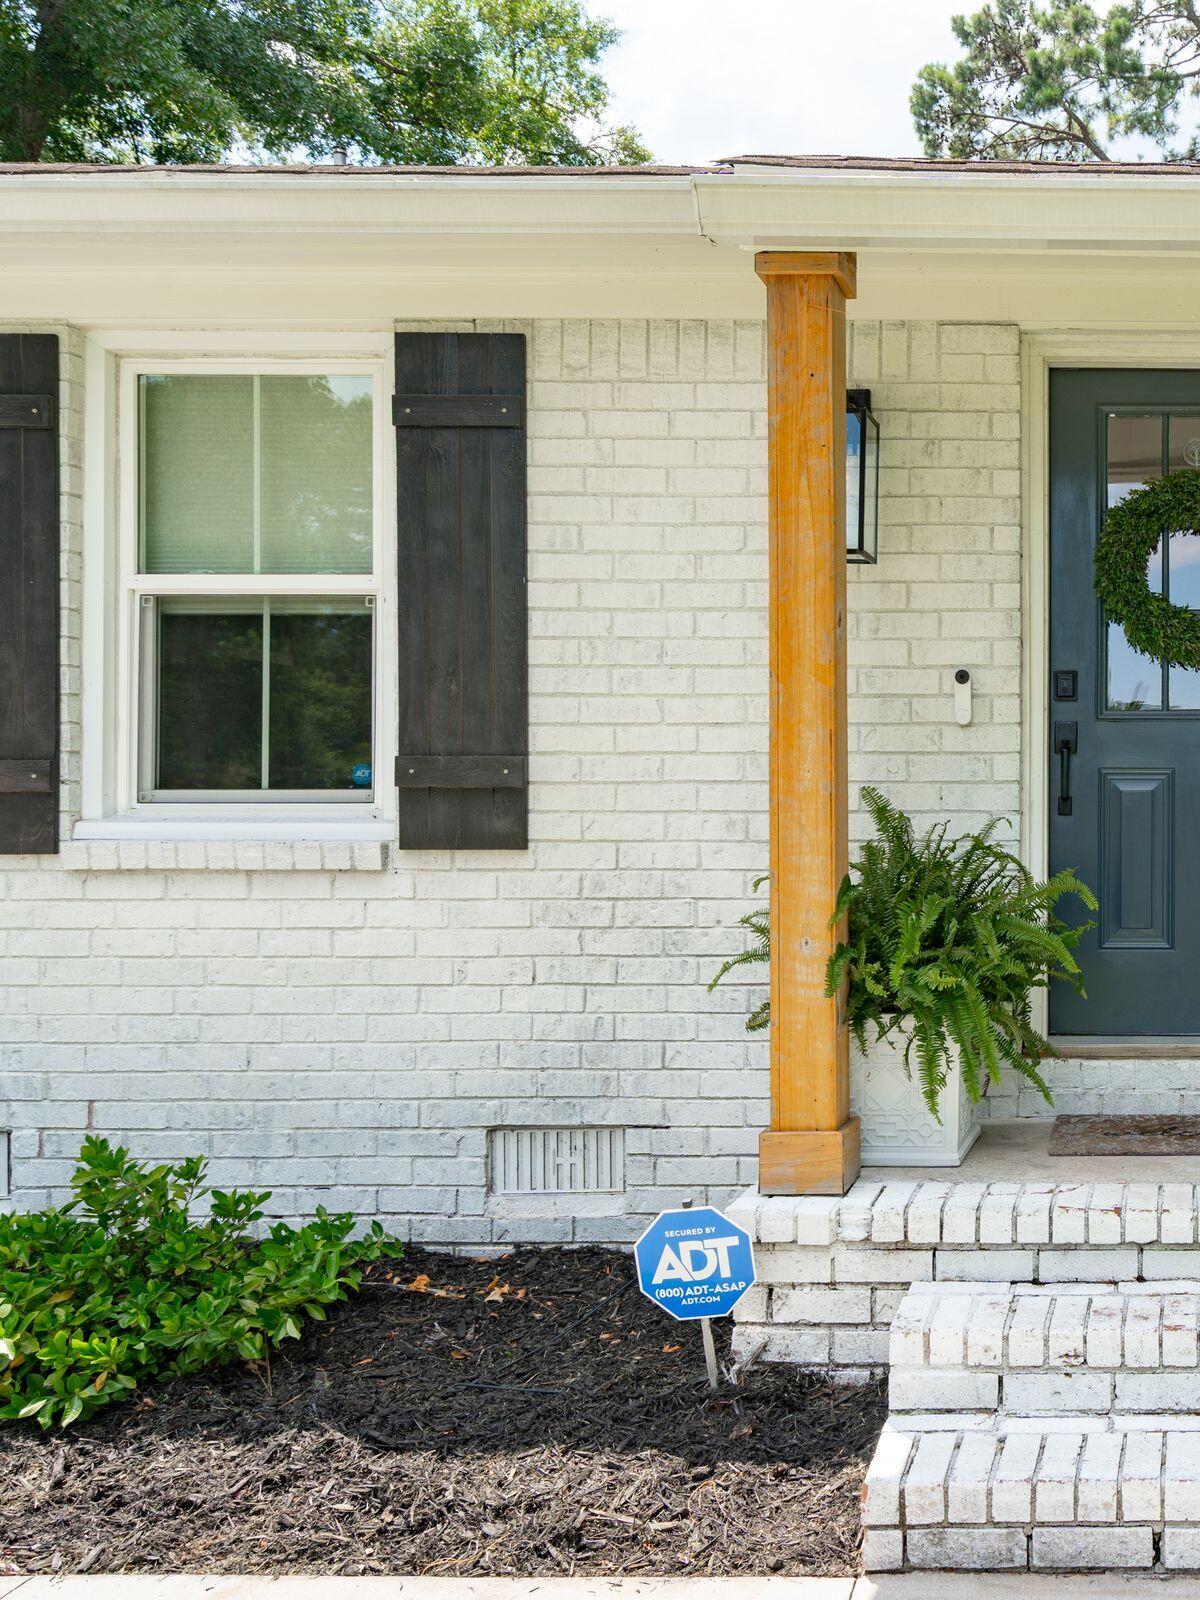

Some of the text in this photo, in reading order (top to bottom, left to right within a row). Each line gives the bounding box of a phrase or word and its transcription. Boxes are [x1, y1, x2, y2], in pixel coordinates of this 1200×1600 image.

[664, 1226, 716, 1238] SECURED BY
[652, 1236, 739, 1285] ADT
[655, 1281, 746, 1300] (800) ADT-ASAP
[681, 1295, 721, 1305] ADT.COM
